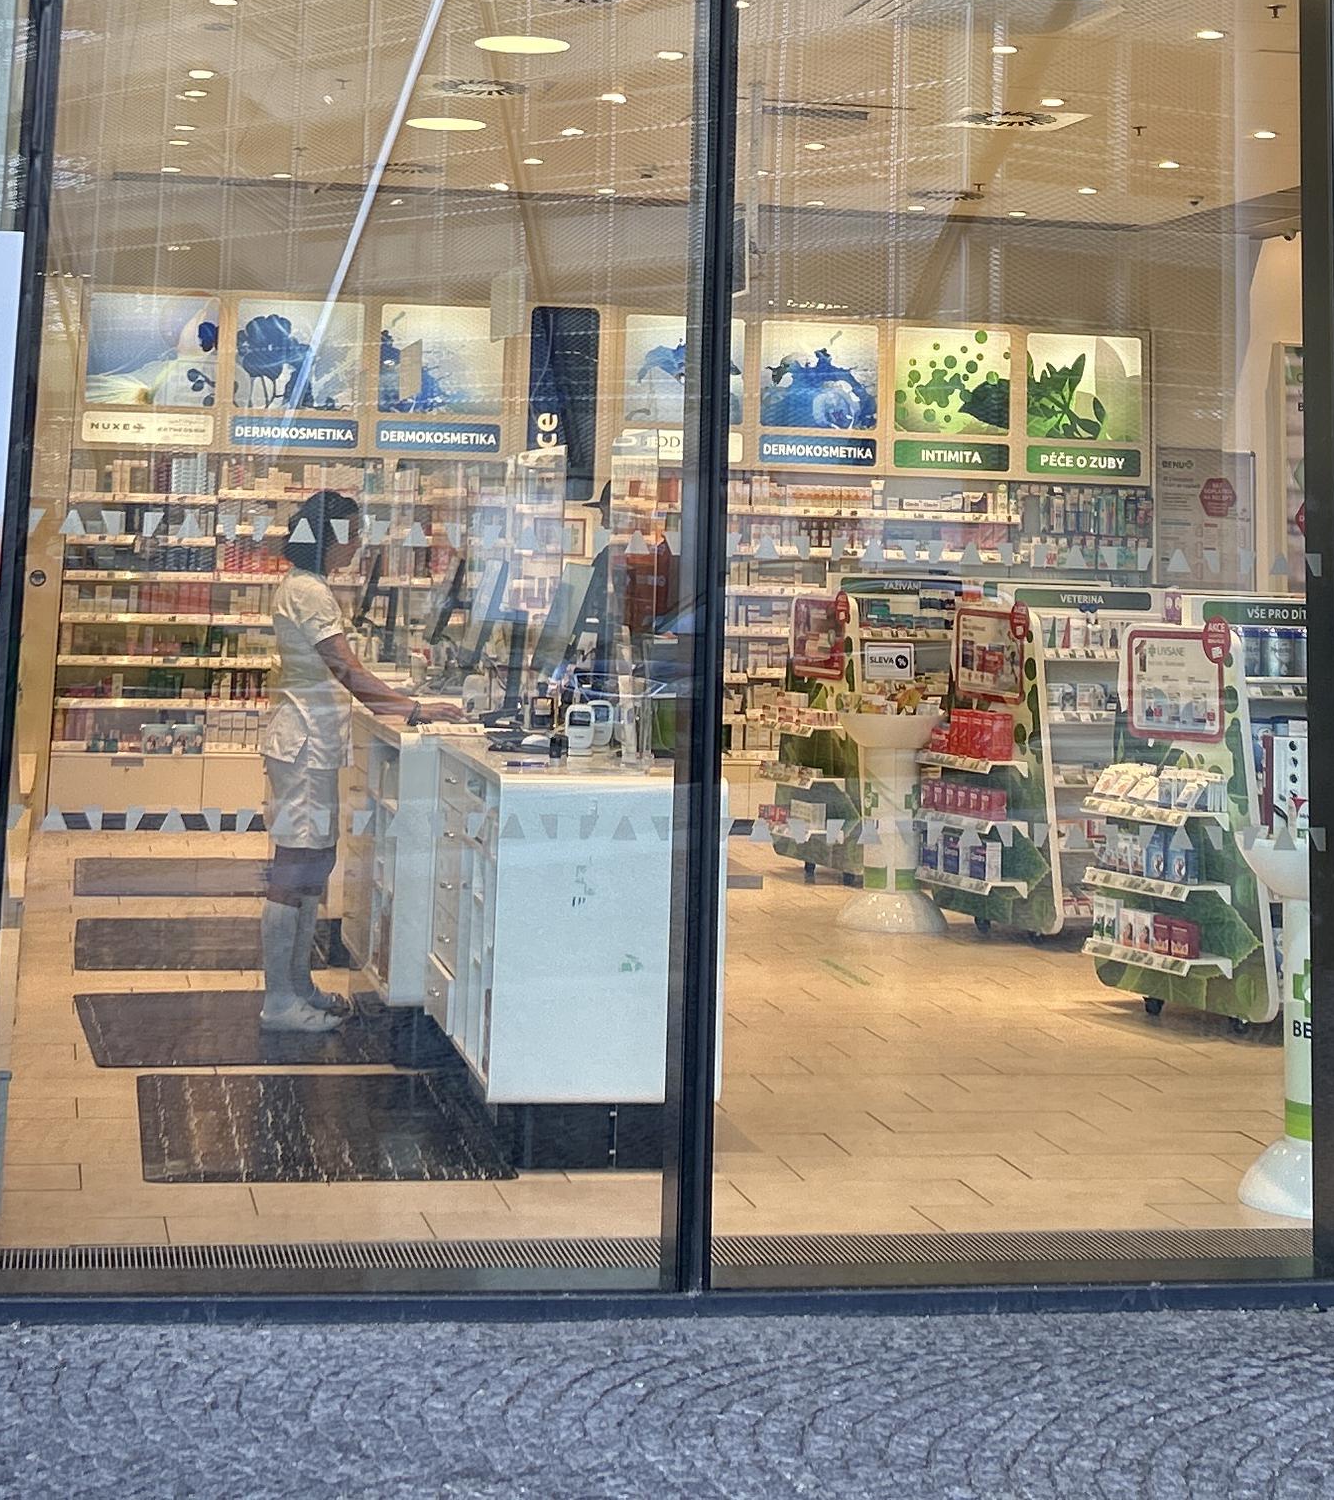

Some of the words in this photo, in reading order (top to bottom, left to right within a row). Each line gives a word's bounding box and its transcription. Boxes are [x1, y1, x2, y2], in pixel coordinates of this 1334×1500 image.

[91, 422, 130, 430] NUXE
[234, 425, 354, 441] DERMOKOSMETIKA
[380, 430, 496, 445] DERMOKOSMETIKA
[763, 443, 873, 460] DERMOKOSMETIKA
[921, 448, 982, 464] INTIMITA
[1040, 451, 1075, 468] PÉČE
[1077, 455, 1087, 467] O
[1090, 455, 1126, 470] ZUBY
[1060, 594, 1104, 604] VETERINA
[1247, 607, 1266, 618] VŠE
[1268, 610, 1289, 619] PRO
[1207, 622, 1226, 633] AKCE
[869, 656, 895, 665] SLEVA
